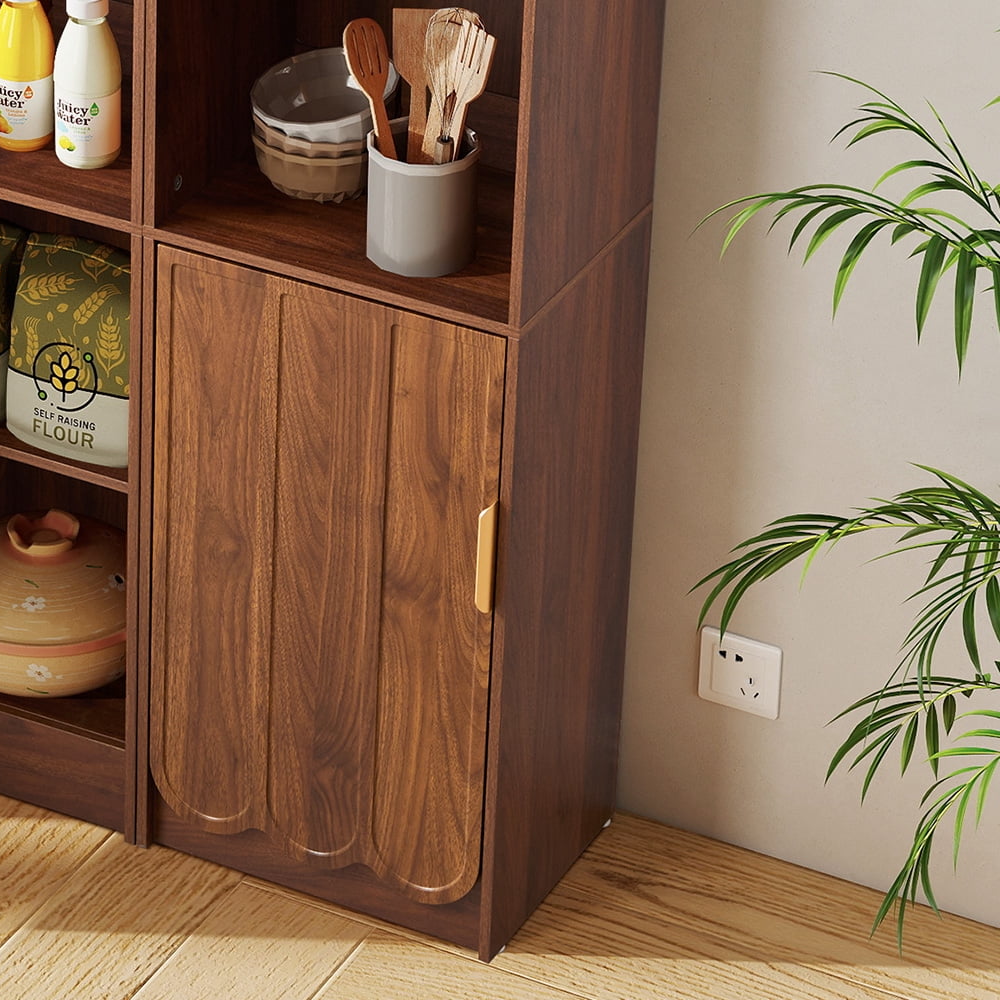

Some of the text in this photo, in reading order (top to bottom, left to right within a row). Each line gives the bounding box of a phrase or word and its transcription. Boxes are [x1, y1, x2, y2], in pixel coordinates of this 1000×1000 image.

[58, 98, 89, 118] Juicy
[58, 109, 91, 126] Water
[34, 407, 96, 431] SELF RAISING
[33, 418, 94, 449] FLOUR
